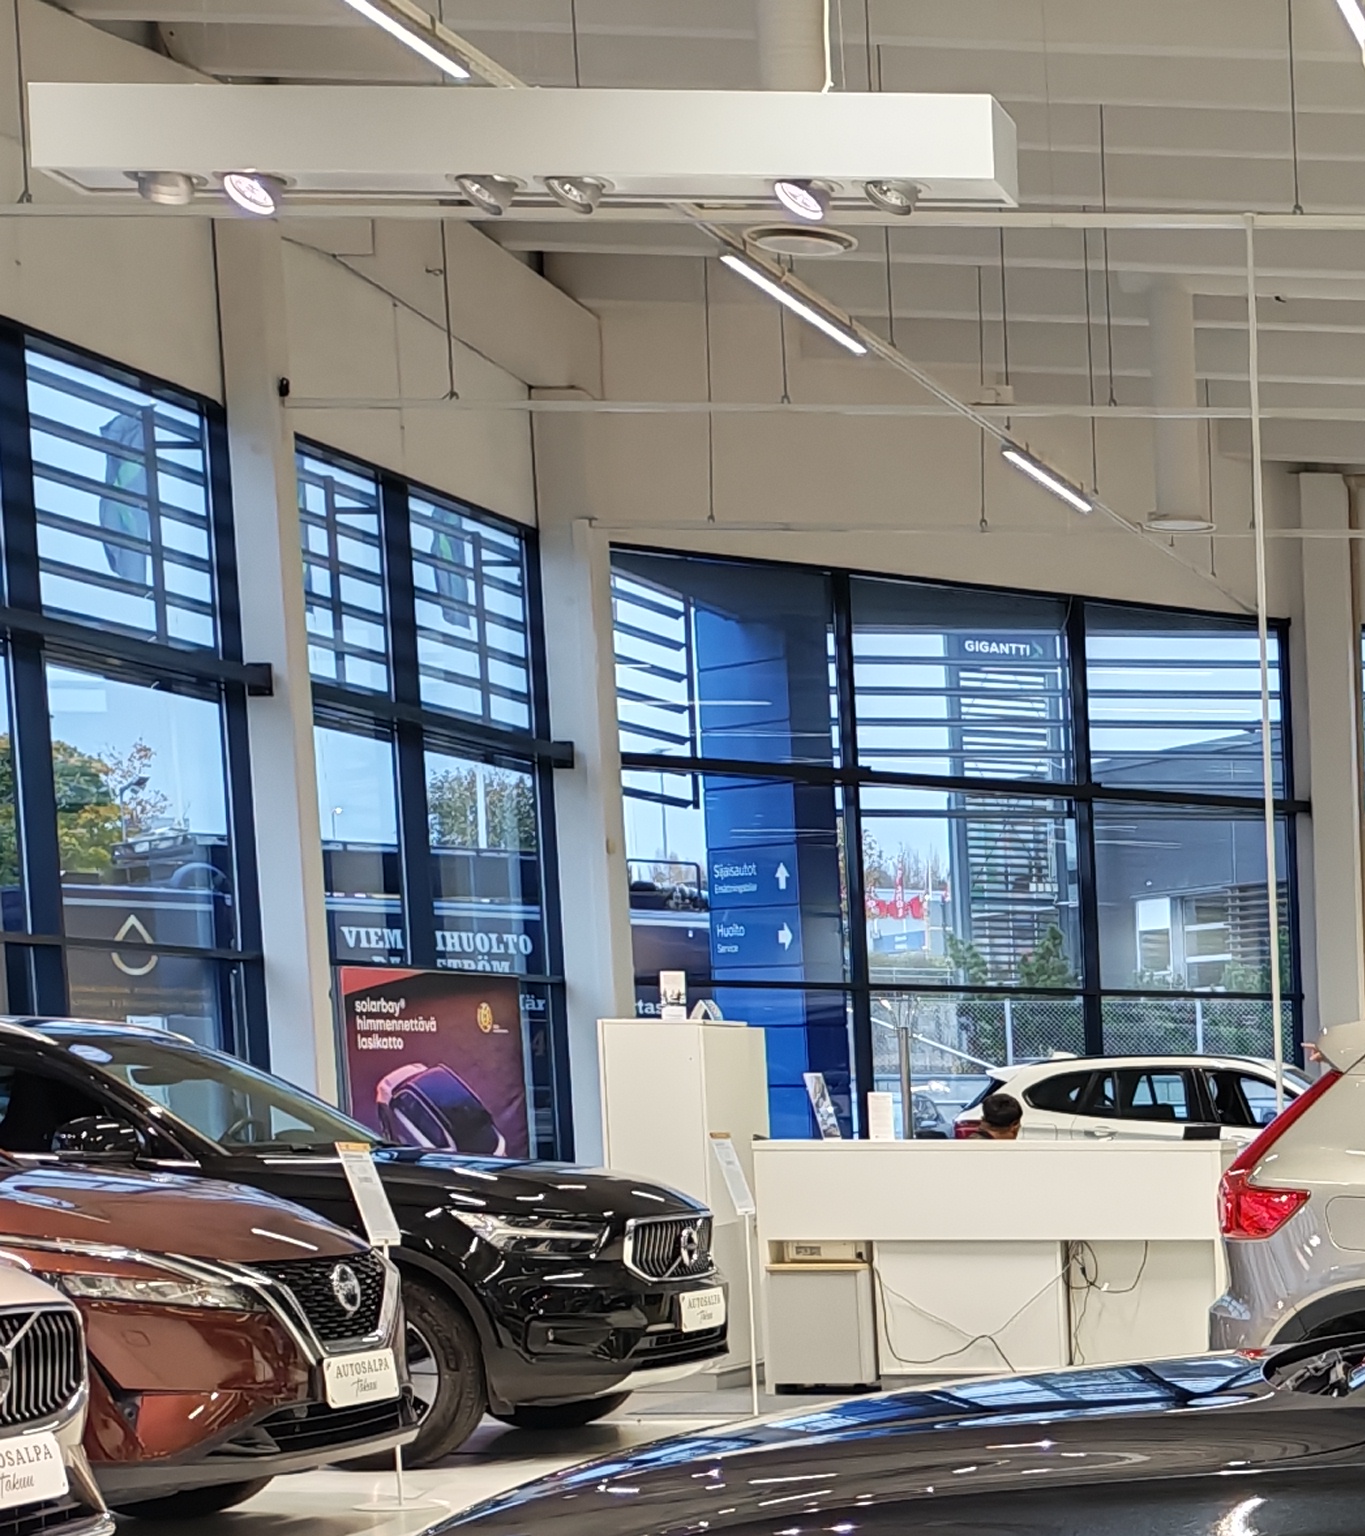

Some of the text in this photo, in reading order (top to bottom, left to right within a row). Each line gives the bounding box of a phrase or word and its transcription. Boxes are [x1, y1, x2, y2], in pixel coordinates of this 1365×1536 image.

[964, 640, 1031, 657] GIGANTTI
[356, 1015, 437, 1032] himmennettävä
[357, 1033, 404, 1050] lasikatto
[335, 1357, 390, 1379] AUTOSALPA
